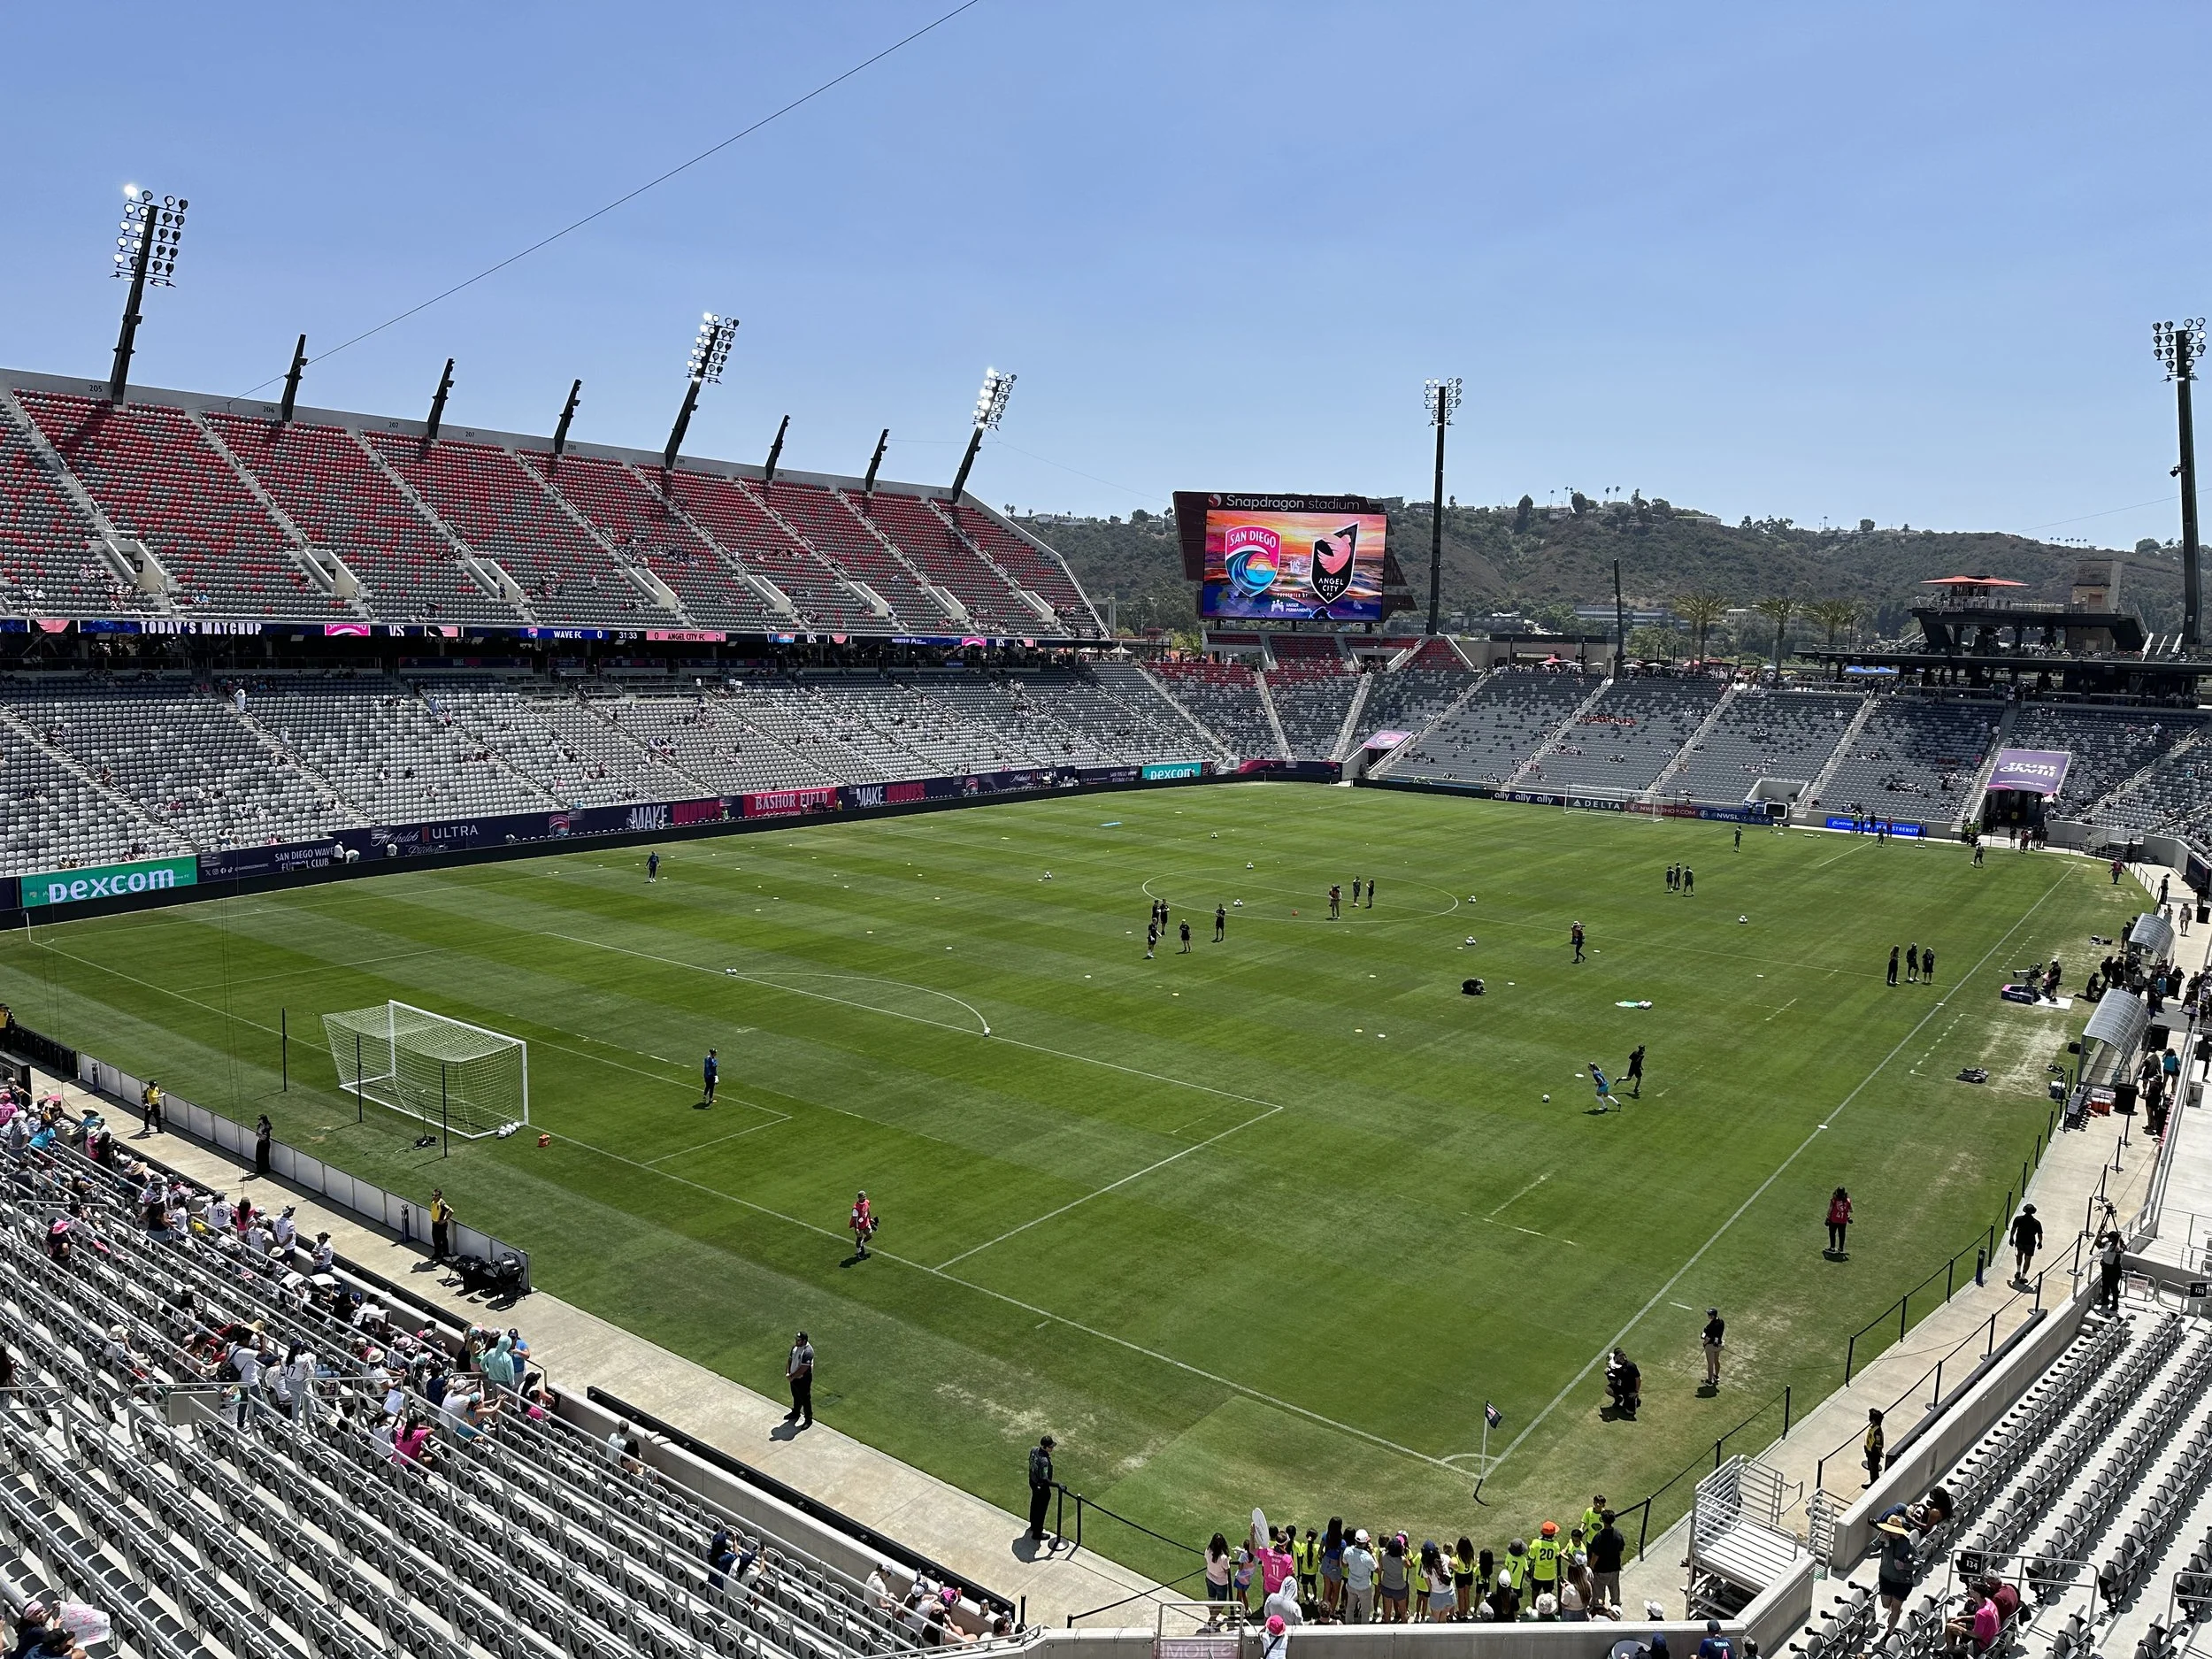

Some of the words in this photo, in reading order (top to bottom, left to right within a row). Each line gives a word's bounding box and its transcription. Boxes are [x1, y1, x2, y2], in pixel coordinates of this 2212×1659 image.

[89, 384, 103, 393] 205
[263, 405, 275, 414] 206
[1226, 494, 1304, 511] Snapdragon
[1308, 497, 1360, 511] stadium
[1229, 530, 1248, 547] SAN
[1248, 530, 1277, 549] DIEGO
[1289, 560, 1301, 575] VS
[1317, 577, 1344, 586] ANGEL
[140, 621, 196, 634] TODAY'S
[202, 622, 262, 635] MATCHUP
[388, 625, 405, 637] VS
[553, 630, 573, 639] WAVE
[597, 630, 603, 639] 0
[618, 631, 638, 640] 31:33
[806, 634, 817, 644] VS
[995, 638, 1005, 647] VS
[2009, 762, 2057, 771] trust
[755, 793, 796, 810] BASHOR
[856, 786, 883, 805] MAKE
[1494, 790, 1509, 801] ally
[1515, 793, 1532, 803] ally
[1536, 795, 1554, 805] ally
[1584, 800, 1621, 810] DELTA
[632, 804, 668, 830] MAKE
[371, 831, 420, 847] Michelob
[432, 825, 479, 840] ULTRA
[274, 853, 289, 863] SAN
[291, 849, 313, 860] DIEGO
[315, 846, 334, 856] WAVE
[281, 860, 310, 872] FÚL
[311, 857, 329, 868] CLUB
[1, 1109, 11, 1118] 10
[216, 1208, 225, 1217] 13
[1540, 1548, 1555, 1561] 20
[1271, 1563, 1279, 1578] 11
[1511, 1560, 1518, 1572] 7
[1966, 1559, 1978, 1571] 134
